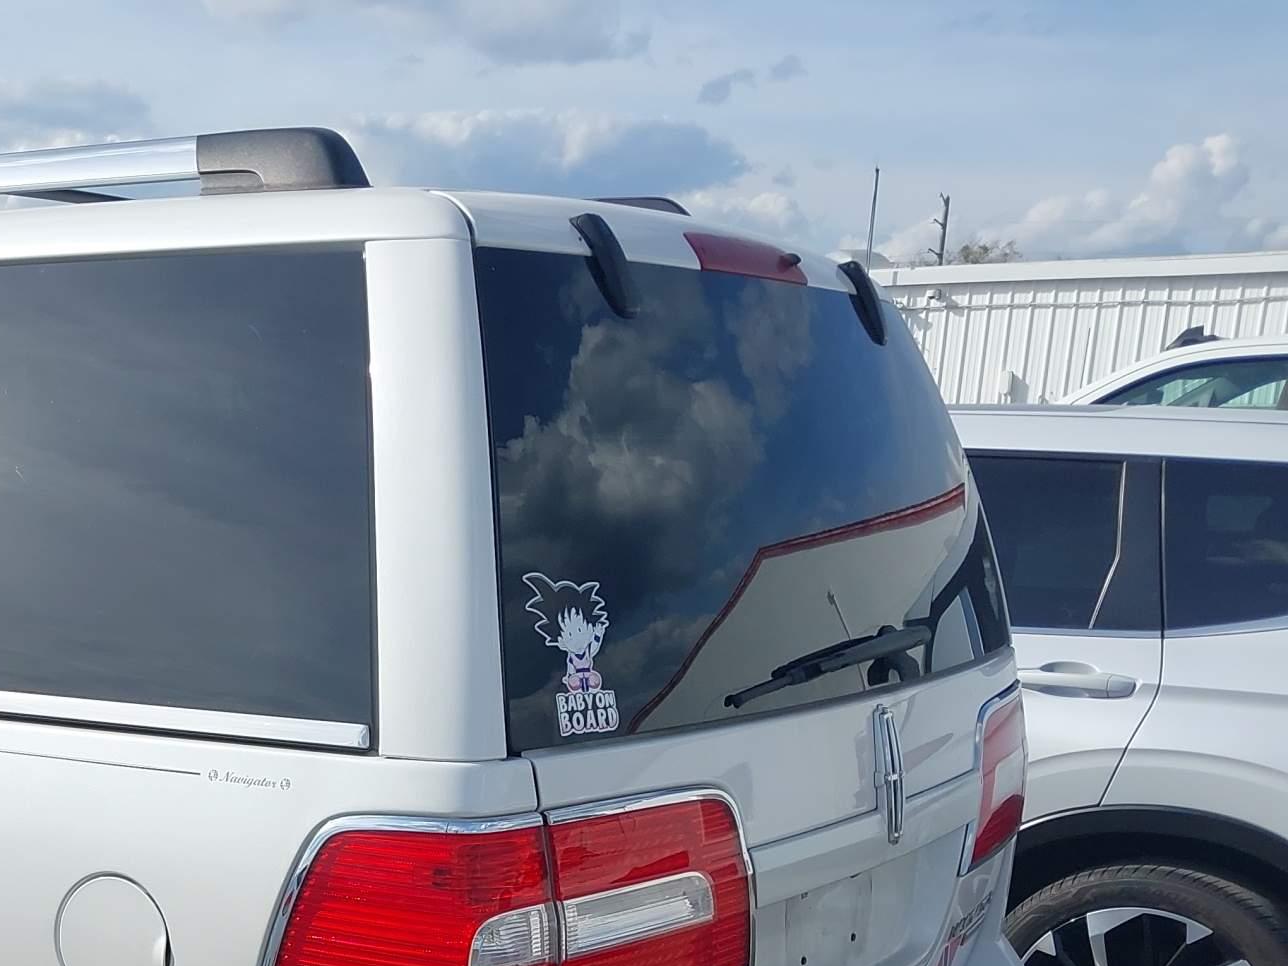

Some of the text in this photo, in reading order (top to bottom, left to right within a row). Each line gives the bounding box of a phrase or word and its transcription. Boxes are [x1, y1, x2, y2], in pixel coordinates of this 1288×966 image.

[558, 692, 615, 713] BABY ON
[560, 707, 618, 733] BOARD
[218, 771, 277, 789] Navigator
